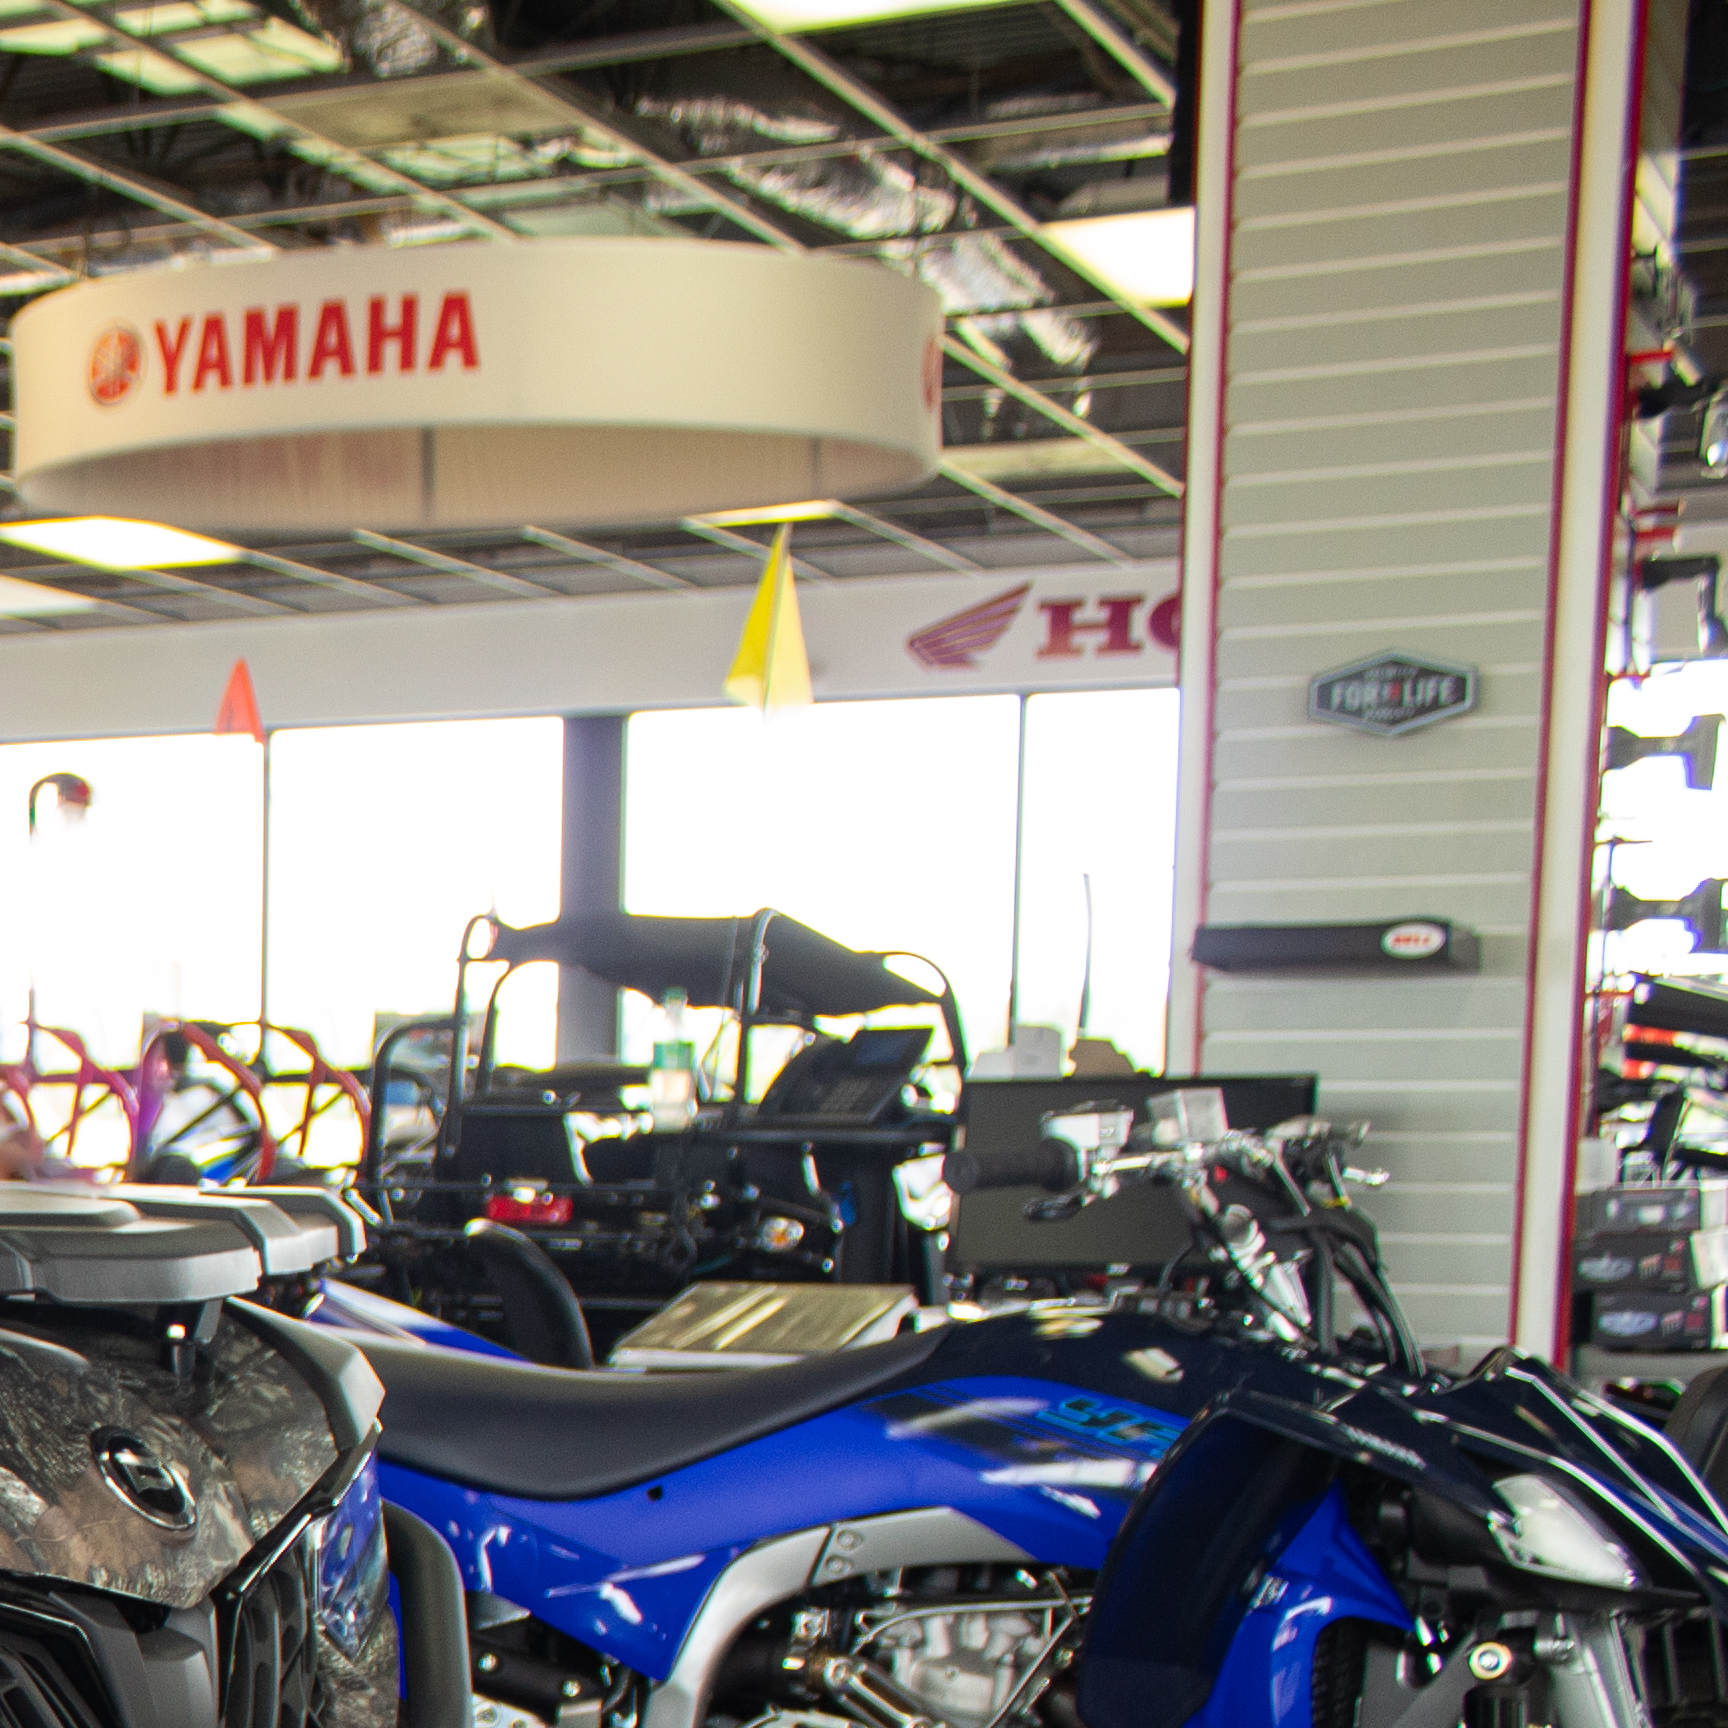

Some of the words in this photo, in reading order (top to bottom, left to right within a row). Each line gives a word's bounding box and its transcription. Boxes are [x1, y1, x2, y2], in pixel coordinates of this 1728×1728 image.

[156, 291, 481, 397] YAMAHA
[1330, 681, 1380, 712] FOR
[1402, 676, 1457, 708] LIFE
